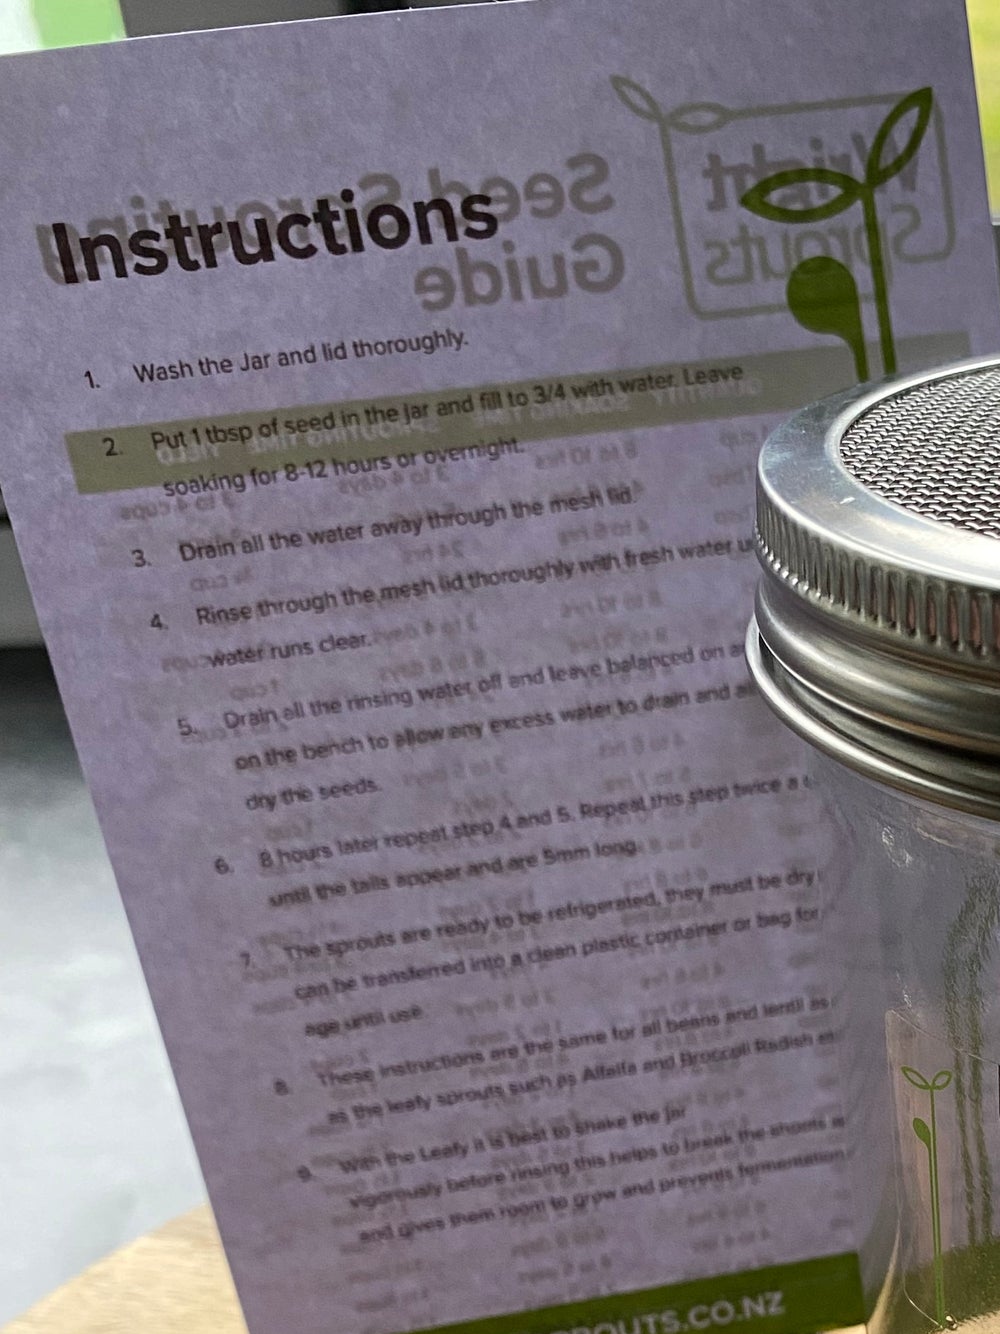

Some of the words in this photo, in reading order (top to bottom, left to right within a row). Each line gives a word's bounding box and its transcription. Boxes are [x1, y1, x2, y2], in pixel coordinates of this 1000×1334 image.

[52, 188, 498, 284] Instructions
[84, 370, 101, 389] 1.
[132, 359, 195, 384] Wash
[198, 355, 234, 377] the
[239, 350, 274, 373] Jar
[278, 346, 318, 369] and
[321, 338, 348, 363] lid
[352, 328, 470, 359] thoroughly.
[102, 437, 123, 457] 2.
[151, 429, 188, 452] Put
[191, 427, 200, 445] 1
[205, 424, 251, 445] tbsp
[258, 417, 279, 438] of
[284, 410, 336, 434] seed
[341, 408, 360, 427] in
[363, 405, 399, 426] the
[436, 389, 475, 417] and
[479, 387, 502, 411] fill
[506, 389, 529, 409] to
[532, 381, 567, 405] 3/4
[570, 376, 615, 400] with
[618, 372, 678, 394] water.
[681, 363, 744, 387] Leave
[163, 468, 248, 498] soaking
[250, 464, 280, 487] for
[284, 457, 330, 483] 8-12
[332, 453, 393, 478] hours
[395, 450, 418, 469] or
[423, 436, 524, 466] overnight.
[131, 548, 153, 569] 3.
[178, 537, 237, 563] Drain
[241, 534, 265, 556] all
[268, 530, 303, 551] the
[307, 525, 365, 547] water
[370, 514, 423, 537] away
[426, 502, 507, 530] through
[510, 498, 543, 519] the
[549, 488, 604, 514] mesh
[149, 613, 169, 631] 4.
[195, 602, 252, 627] Rinse
[255, 591, 337, 617] through
[341, 586, 375, 607] the
[379, 577, 436, 600] mesh
[438, 574, 464, 595] lid
[467, 558, 575, 588] thoroughly
[578, 553, 621, 575] with
[624, 545, 675, 568] fresh
[677, 539, 732, 560] water
[177, 717, 199, 737] 5.
[222, 706, 279, 730] Drain
[281, 701, 305, 722] all
[309, 696, 342, 717] the
[346, 688, 414, 714] rinsing
[416, 680, 472, 701] water
[507, 667, 544, 689] and
[548, 660, 603, 683] leave
[605, 648, 695, 676] balanced
[208, 644, 266, 668] water
[270, 639, 314, 661] runs
[234, 753, 262, 771] on
[264, 746, 298, 767] the
[301, 735, 364, 760] bench
[366, 731, 389, 751] to
[394, 724, 445, 746] allow
[448, 718, 483, 741] any
[489, 711, 555, 735] excess
[560, 701, 613, 723] water
[616, 698, 639, 717] to
[641, 690, 691, 712] drain
[694, 684, 731, 704] and
[245, 792, 278, 812] dry
[280, 784, 313, 805] the
